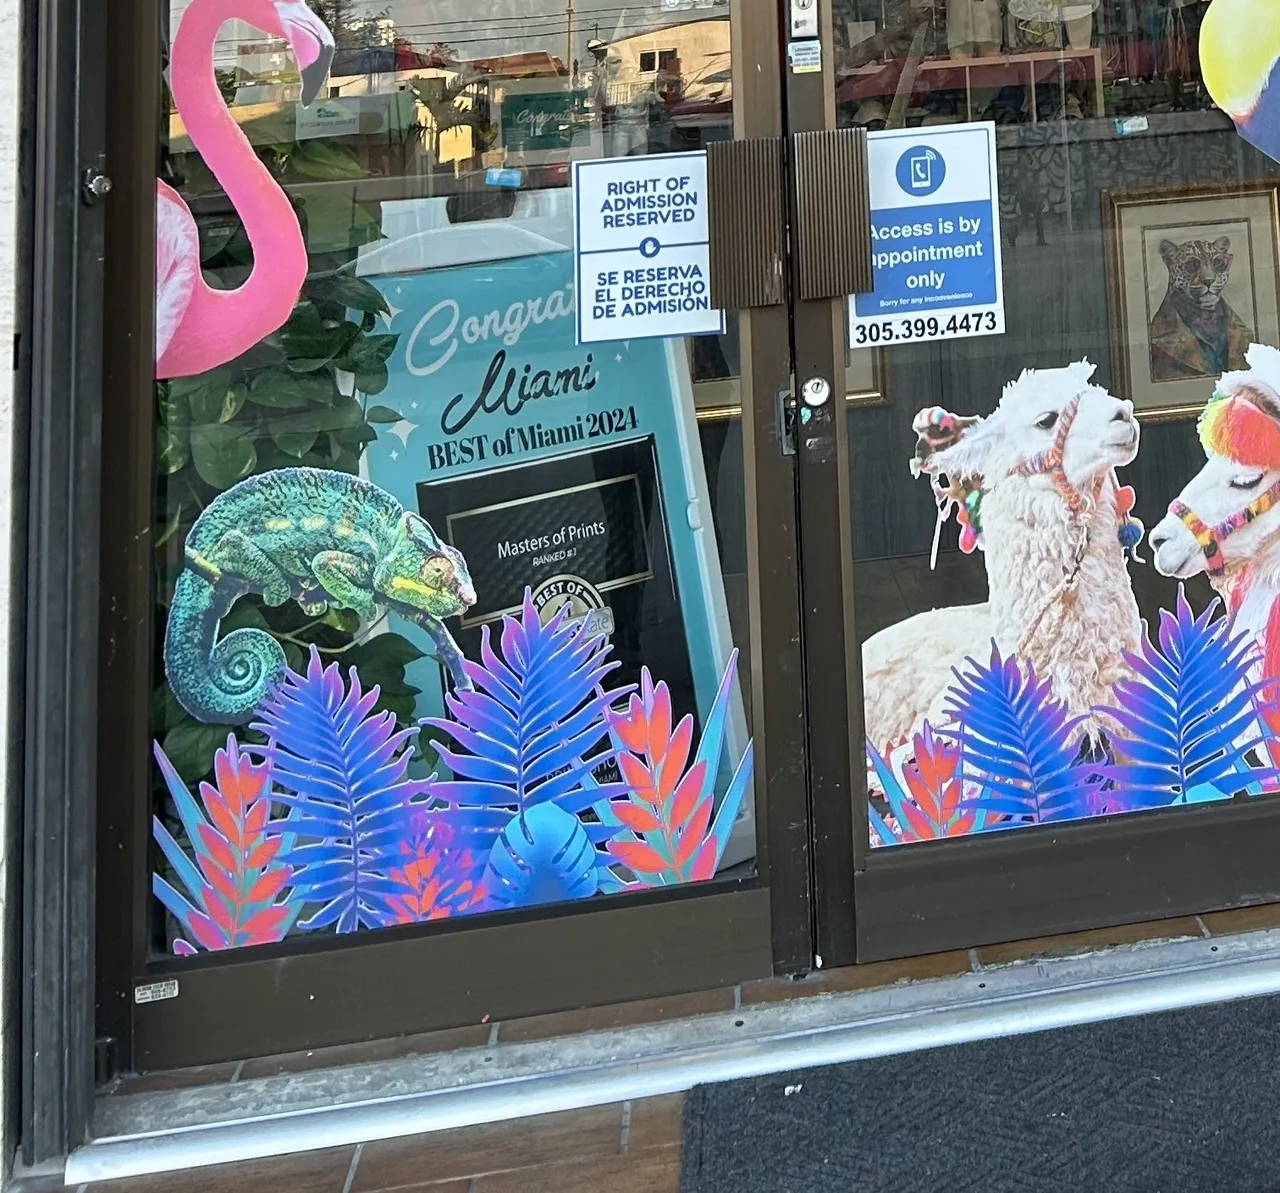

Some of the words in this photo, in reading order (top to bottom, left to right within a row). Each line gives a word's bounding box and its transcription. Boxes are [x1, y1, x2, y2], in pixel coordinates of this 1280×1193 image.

[608, 178, 661, 195] RIGHT
[666, 176, 690, 191] OF
[601, 192, 698, 212] ADMISSION
[603, 208, 696, 228] RESERVED
[938, 218, 954, 234] is
[958, 216, 981, 235] by
[597, 272, 618, 286] SE
[623, 264, 702, 284] RESERVA
[906, 270, 945, 289] only
[595, 289, 616, 303] EL
[622, 281, 706, 301] DERECHO
[592, 305, 616, 319] DE
[621, 295, 708, 317] ADMISIÓN
[855, 311, 997, 343] 305.399.4473
[441, 349, 599, 435] Miami
[427, 434, 488, 470] BEST
[492, 426, 516, 456] of
[517, 415, 585, 452] Miami
[586, 406, 639, 439] 2024
[497, 535, 550, 559] Masters
[552, 527, 566, 545] of
[568, 522, 606, 541] Prints
[532, 551, 566, 566] RANKED
[536, 582, 564, 606] BEST
[566, 582, 584, 595] OF
